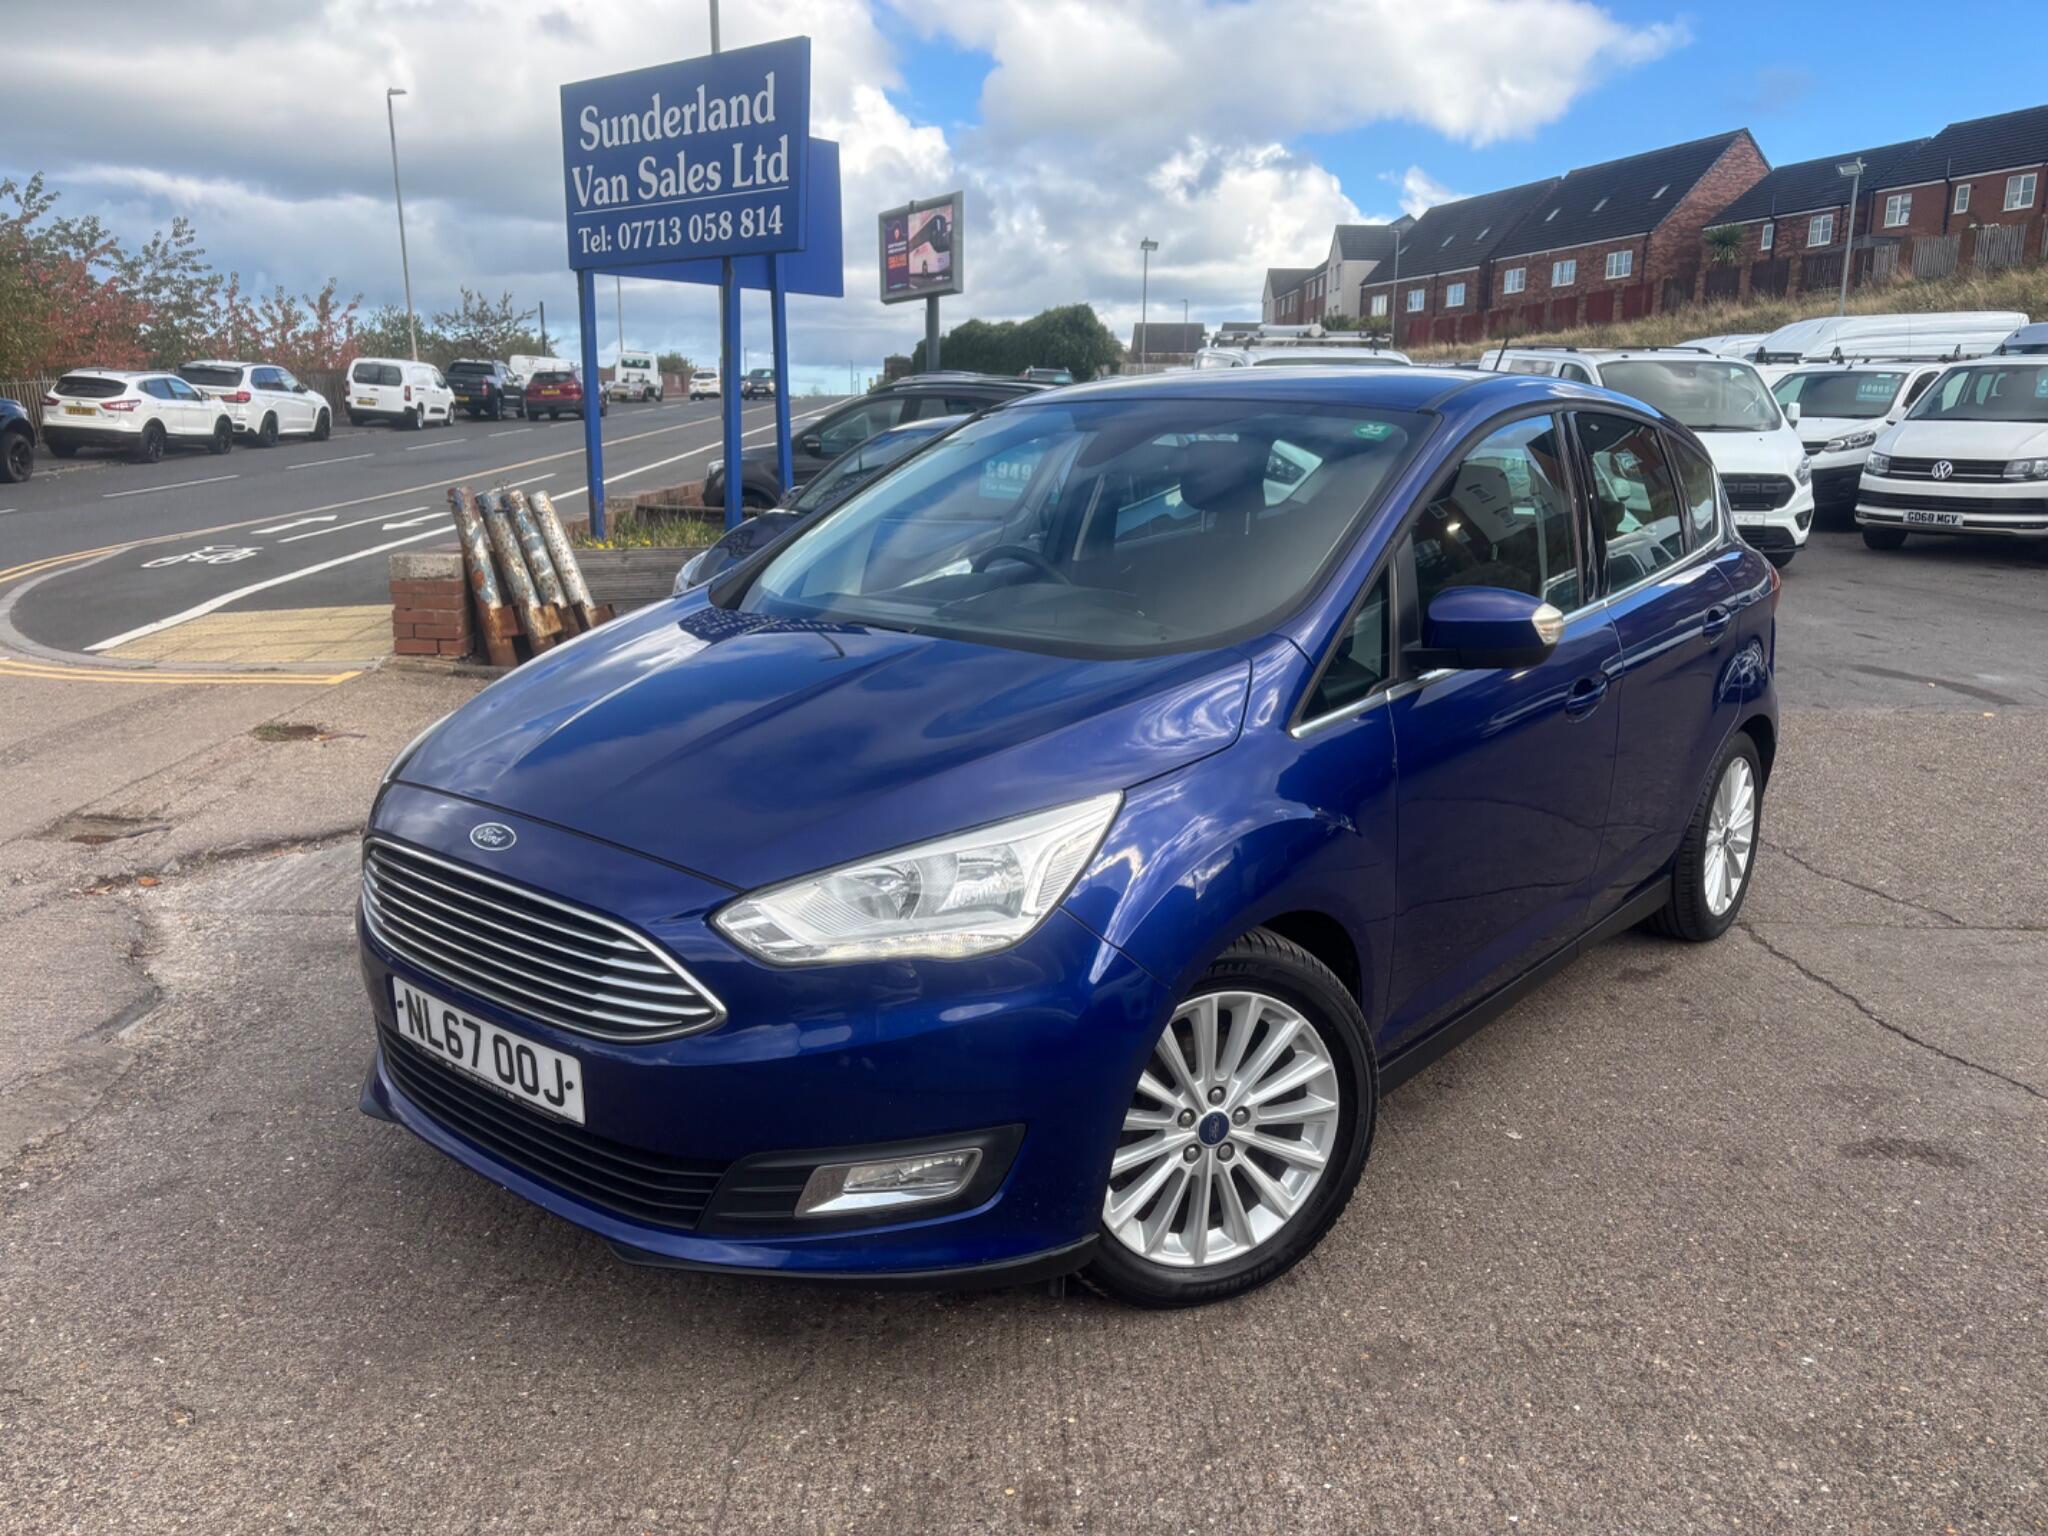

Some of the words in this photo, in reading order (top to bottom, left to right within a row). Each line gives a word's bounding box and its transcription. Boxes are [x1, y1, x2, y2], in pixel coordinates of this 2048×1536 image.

[579, 71, 776, 151] Sunderland
[572, 164, 629, 208] Van
[637, 150, 722, 201] Sales
[732, 134, 790, 189] Ltd
[577, 226, 612, 254] Tel:
[617, 215, 682, 250] 07713
[688, 210, 733, 244] 058
[740, 204, 784, 238] 814
[986, 461, 1037, 481] £949
[1937, 512, 1958, 525] MGV
[475, 826, 507, 845] Ford
[405, 989, 481, 1069] NL67
